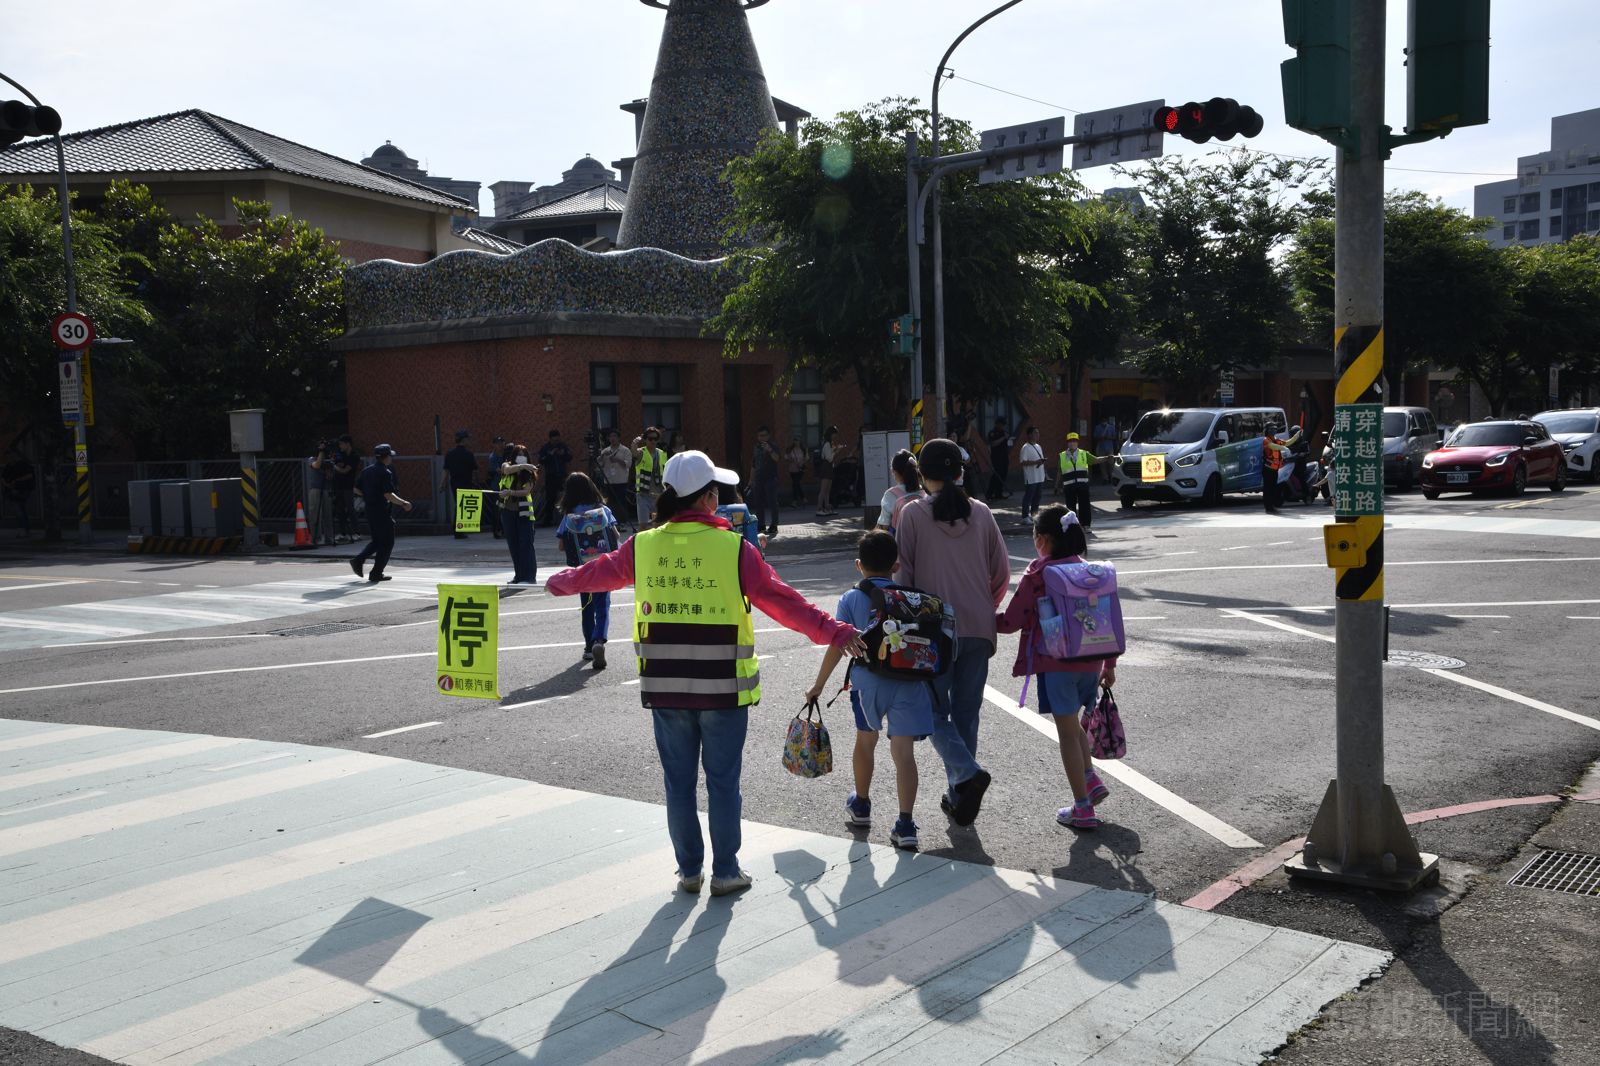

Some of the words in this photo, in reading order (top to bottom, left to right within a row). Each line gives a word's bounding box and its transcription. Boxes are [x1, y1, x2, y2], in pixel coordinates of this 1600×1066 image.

[62, 324, 84, 339] 30
[1335, 410, 1352, 512] 請先按鈕
[1355, 409, 1377, 512] 穿越道路
[459, 493, 479, 520] 停
[658, 556, 703, 570] 新北市
[646, 576, 718, 590] 交通導護志工
[655, 602, 703, 616] 和泰汽車
[440, 596, 489, 668] 停
[455, 677, 494, 693] 和泰汽車
